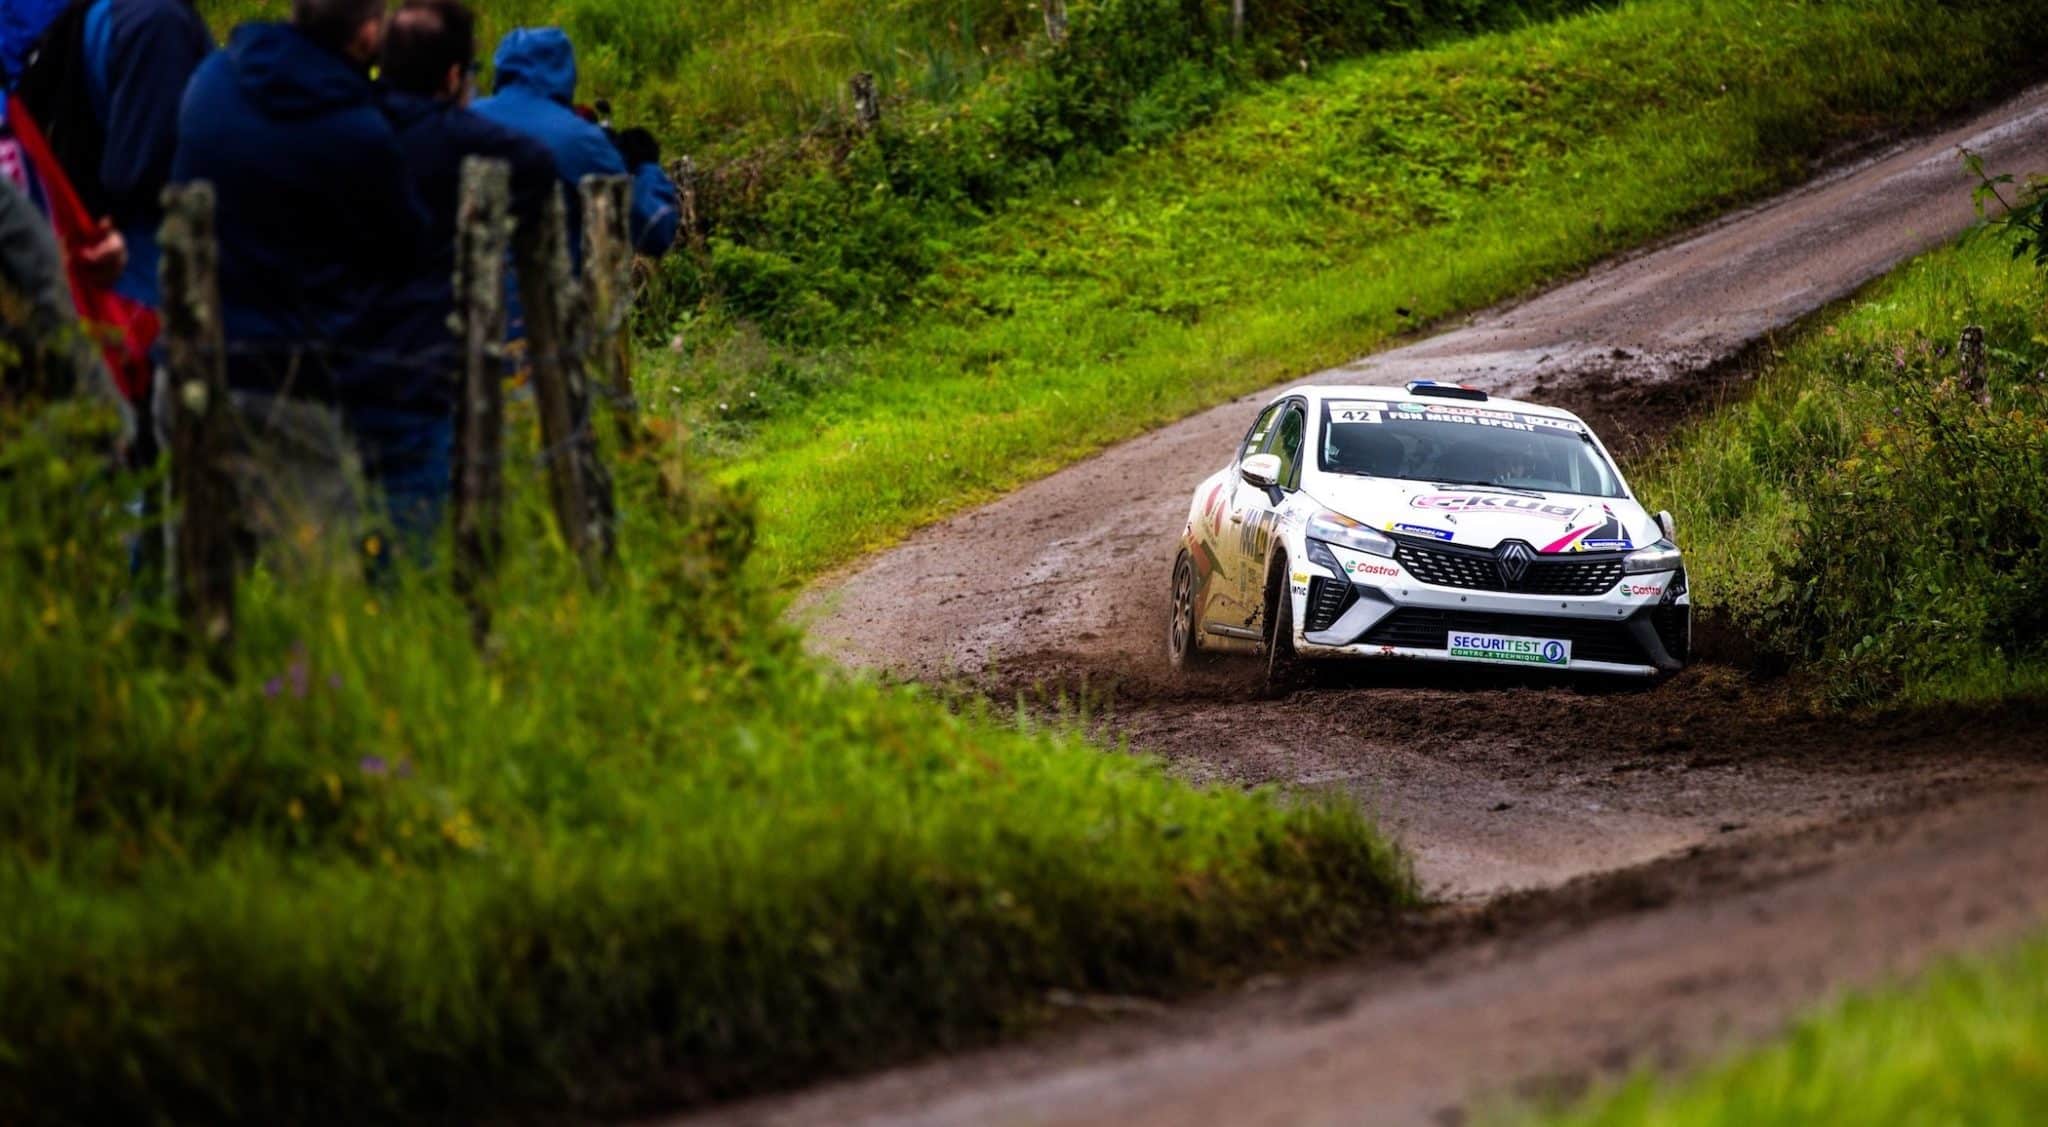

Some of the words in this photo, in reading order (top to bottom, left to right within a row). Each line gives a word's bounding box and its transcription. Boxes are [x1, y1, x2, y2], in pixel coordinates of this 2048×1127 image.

[1341, 411, 1371, 422] 42
[1388, 411, 1424, 421] FUN
[1425, 413, 1477, 425] MECA
[1479, 417, 1536, 432] SPORT
[1356, 562, 1400, 577] Castrol
[1631, 585, 1662, 596] Castrol
[1453, 636, 1541, 653] SECURITEST
[1495, 652, 1541, 662] TECHNIQUE
